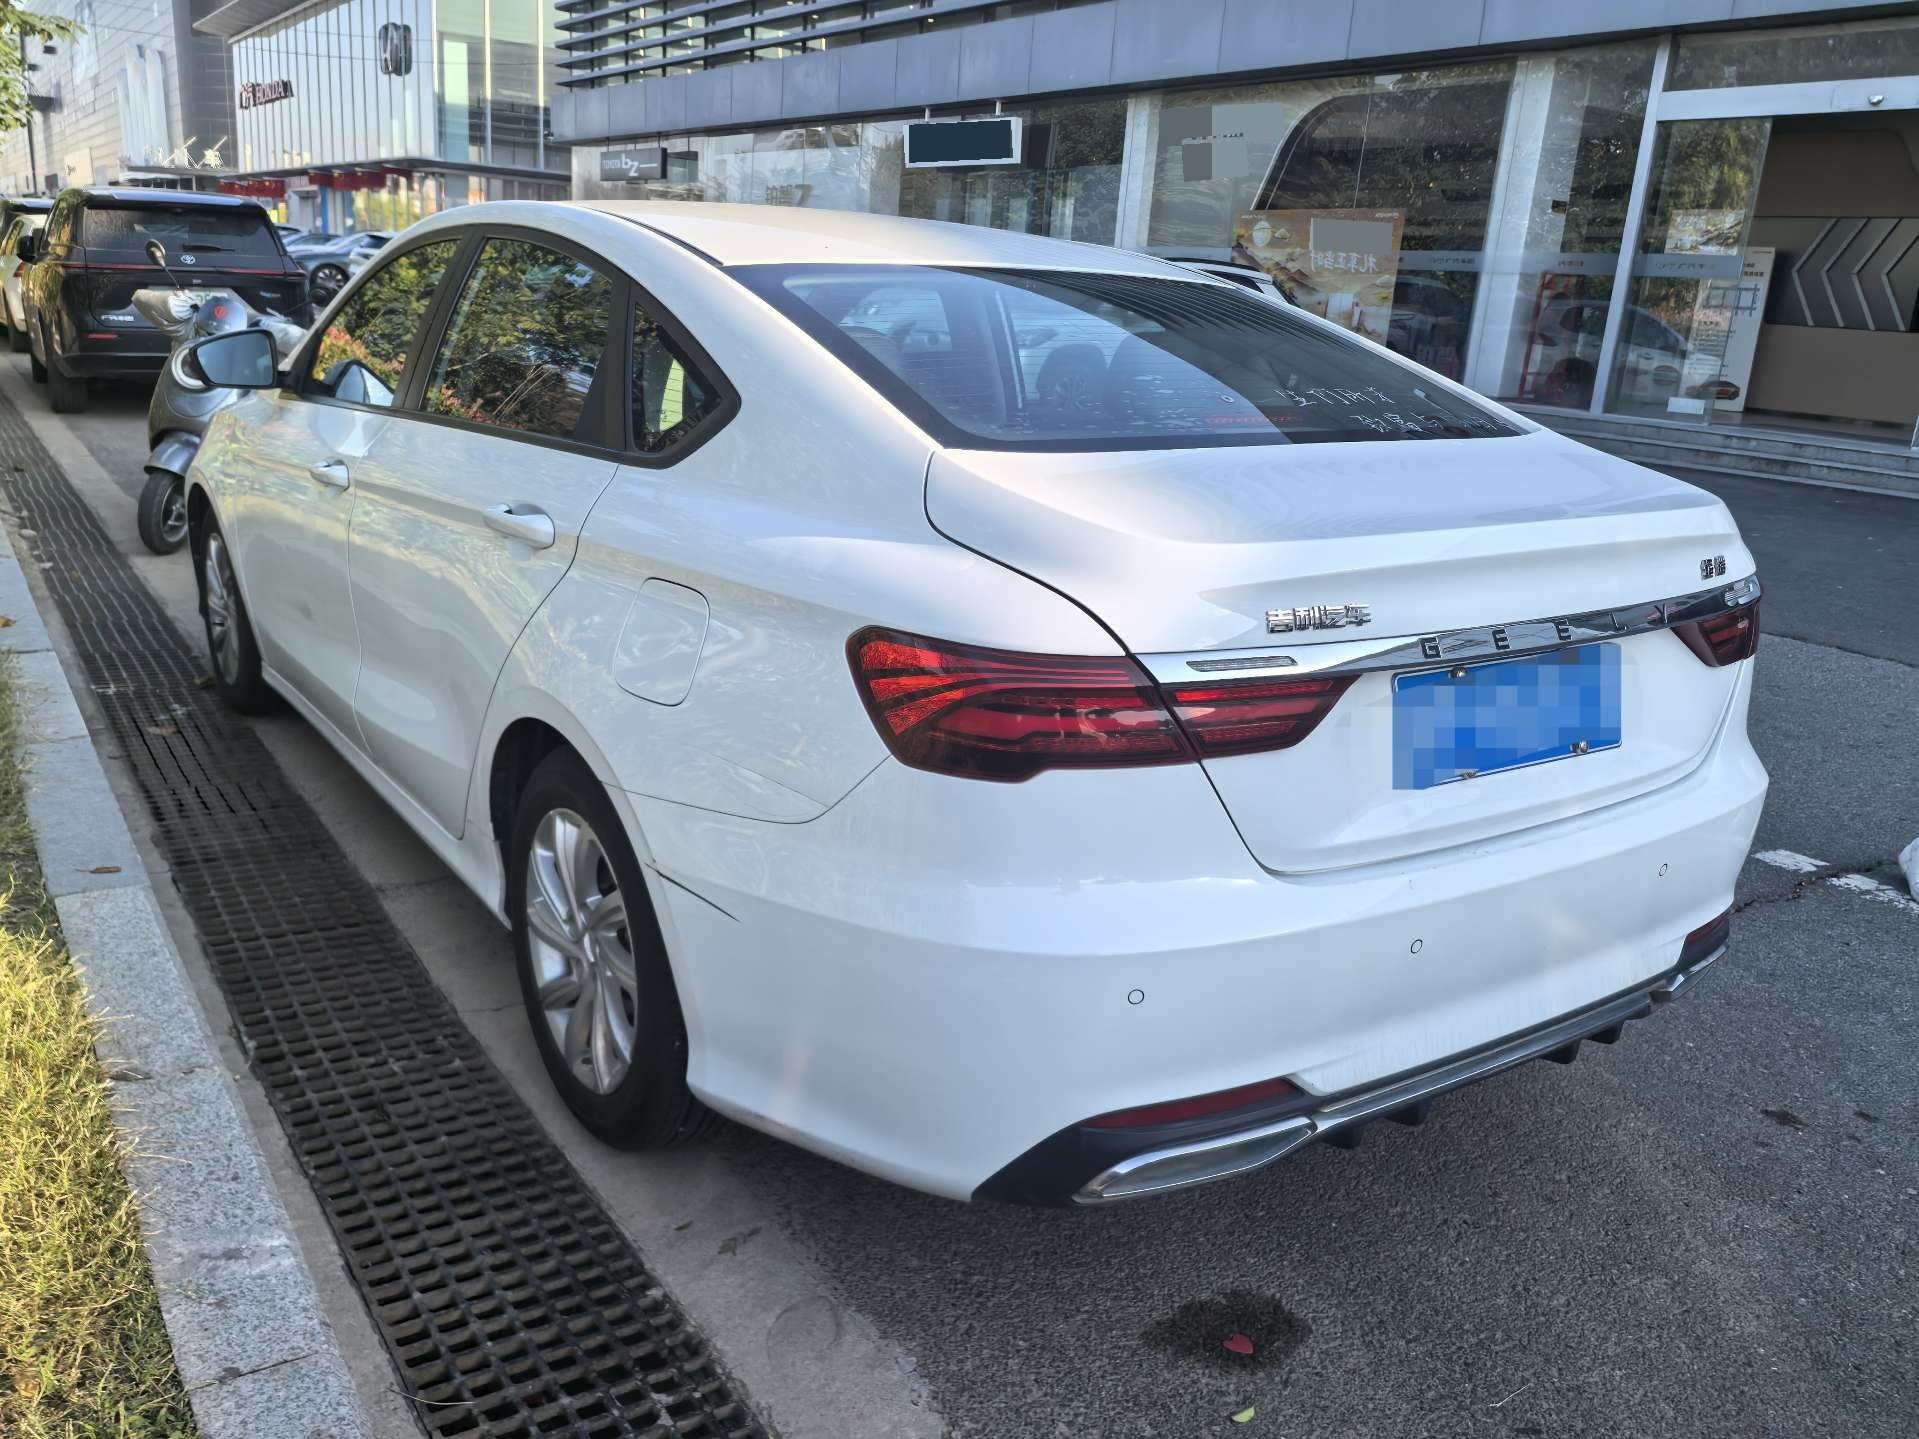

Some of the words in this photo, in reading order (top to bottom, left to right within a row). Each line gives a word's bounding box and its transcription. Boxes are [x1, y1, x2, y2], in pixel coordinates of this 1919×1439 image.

[254, 79, 287, 105] HONDA
[1265, 603, 1371, 633] 吉利汽车
[1419, 602, 1668, 660] GEELY
